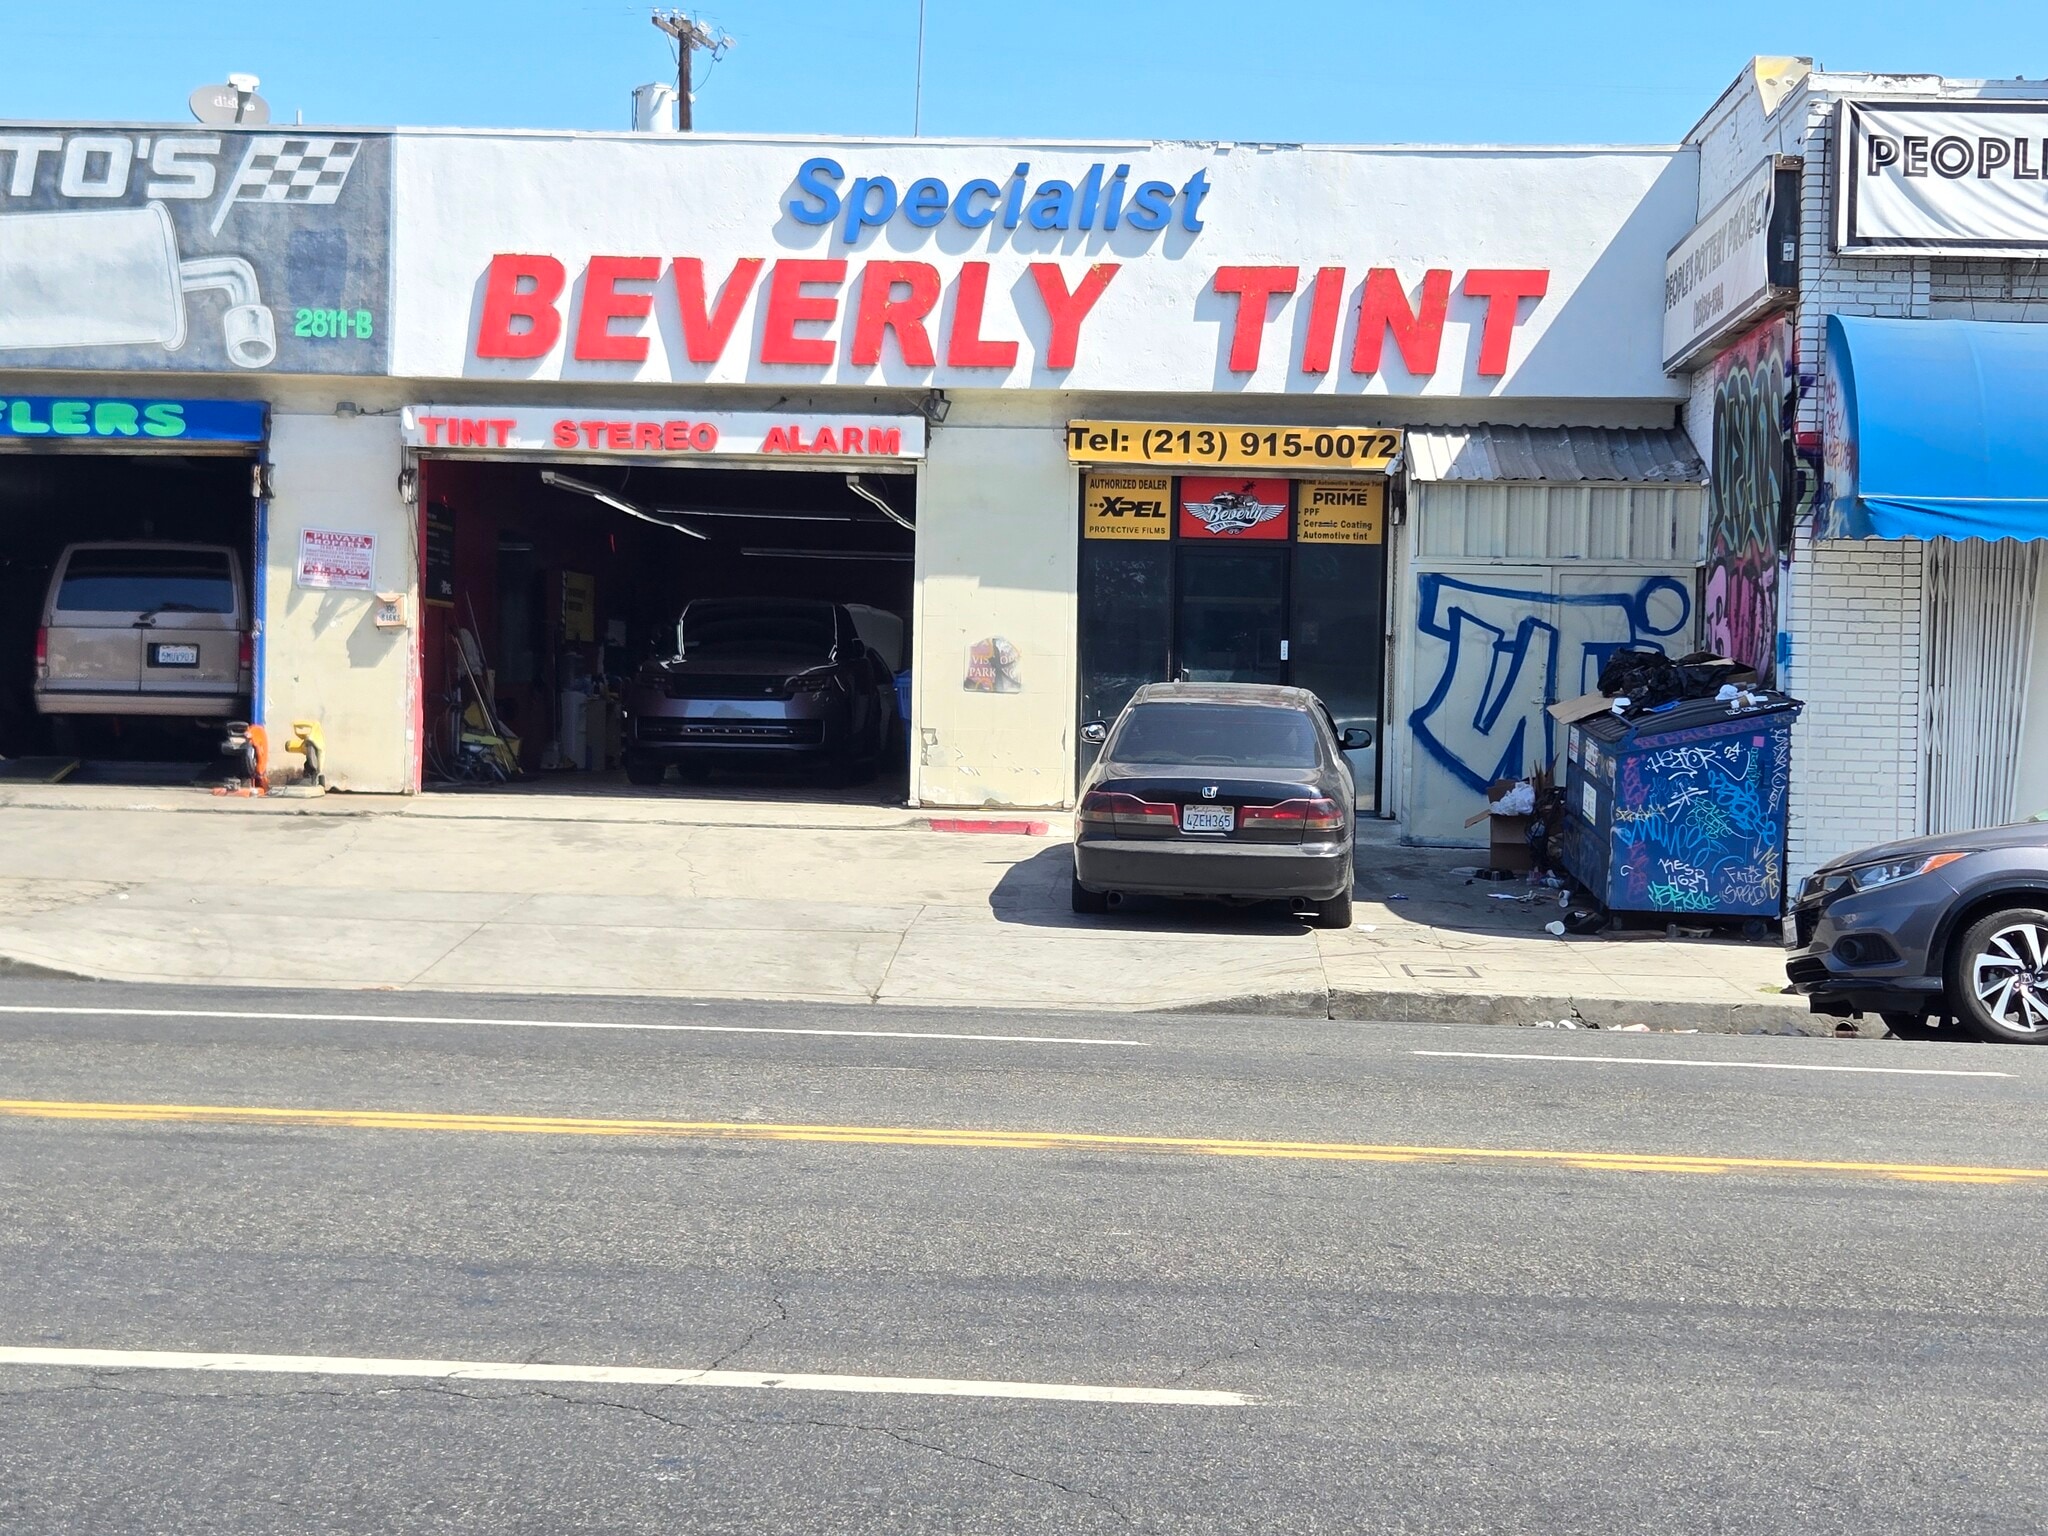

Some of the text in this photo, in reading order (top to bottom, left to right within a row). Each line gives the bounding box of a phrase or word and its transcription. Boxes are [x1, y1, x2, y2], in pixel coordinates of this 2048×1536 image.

[0, 136, 221, 198] TO'S
[1867, 134, 2048, 180] PEOPL
[789, 157, 1211, 244] Specialist
[1694, 221, 1729, 286] POTTERY
[294, 307, 374, 339] 2811-B
[476, 253, 1551, 375] BEVERLY TINT
[418, 416, 902, 456] TINT STEREO ALARM
[1069, 427, 1398, 462] Tel: (213) 915-0072
[1090, 478, 1168, 491] AUTHORIZED DEALER
[1097, 496, 1167, 518] XPEL
[1313, 491, 1368, 507] PRIME
[1208, 501, 1263, 523] Beverly
[1303, 507, 1320, 516] PPF
[1089, 525, 1167, 535] PROTECTIVE FILMS
[1303, 530, 1368, 541] Automotive tint
[1340, 520, 1373, 531] Coating
[306, 537, 371, 549] PROPERTY
[313, 532, 363, 542] PRIVATE
[1186, 813, 1231, 828] 4ZEH365
